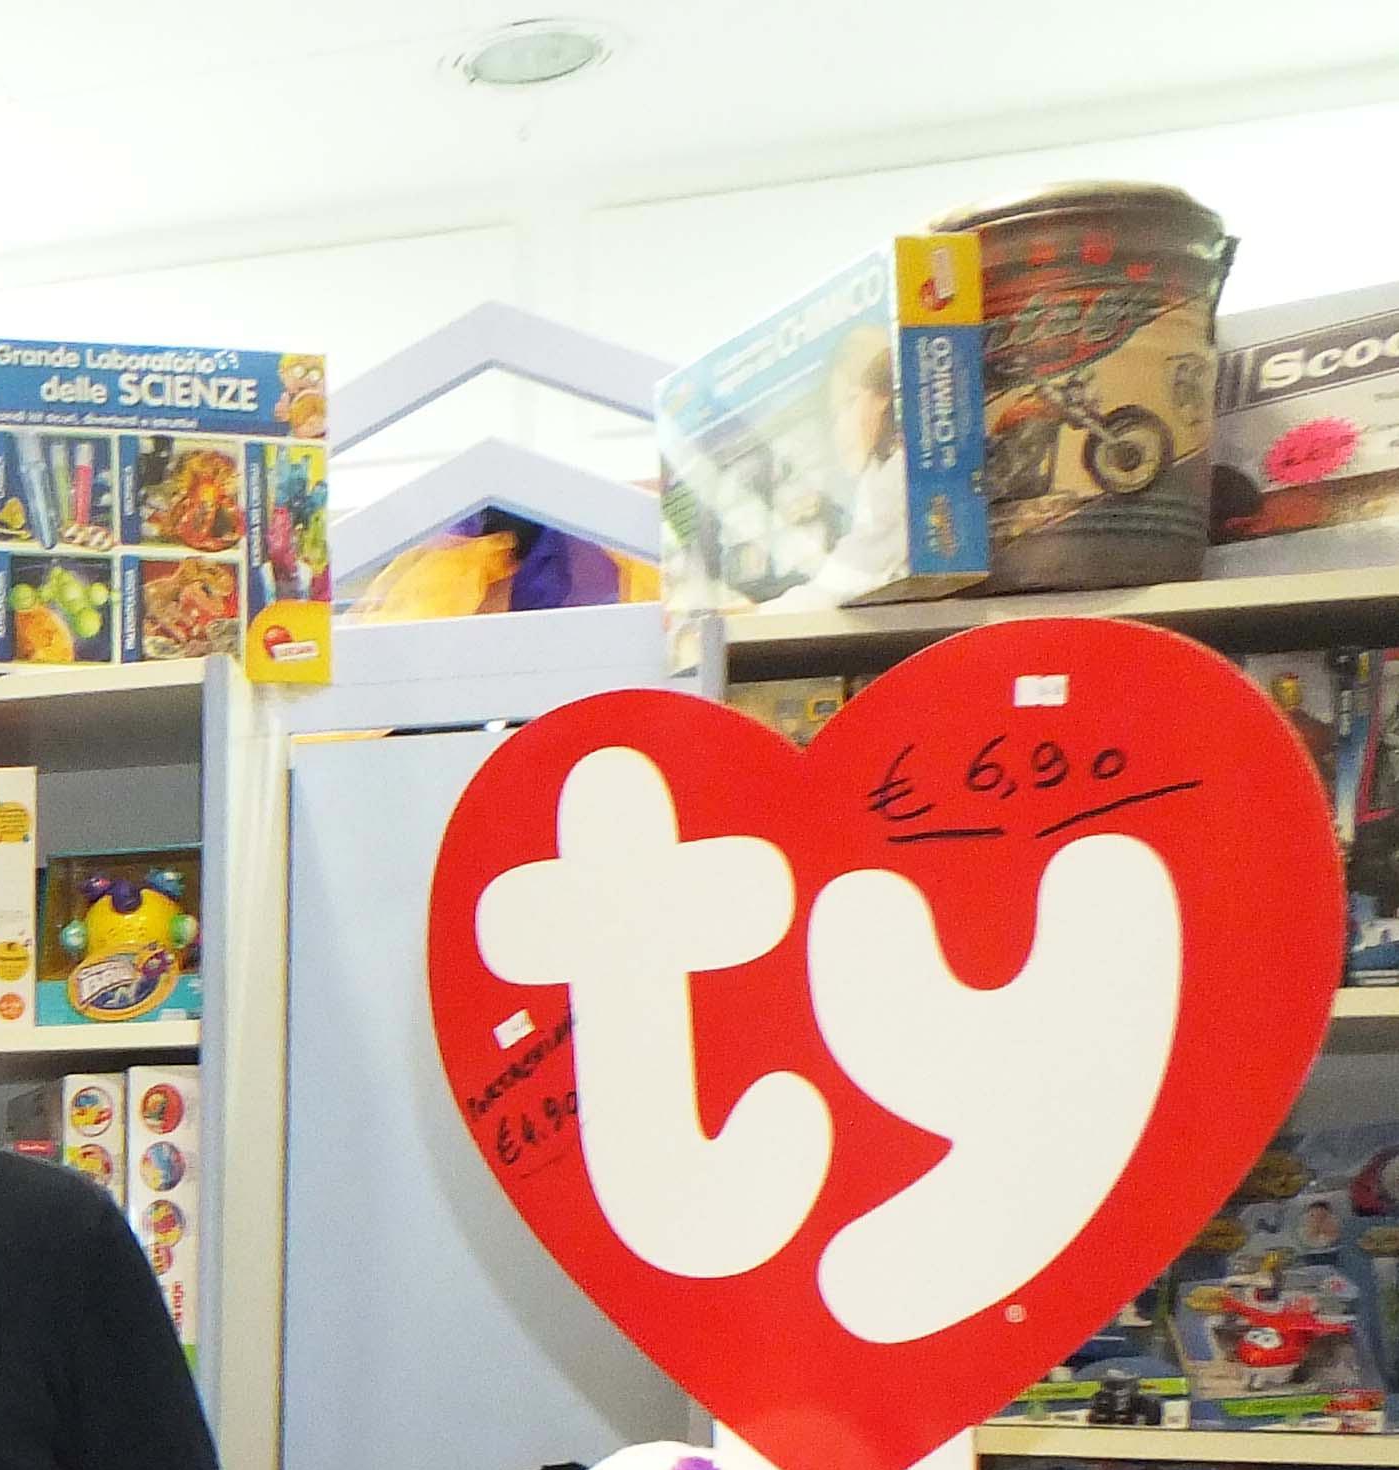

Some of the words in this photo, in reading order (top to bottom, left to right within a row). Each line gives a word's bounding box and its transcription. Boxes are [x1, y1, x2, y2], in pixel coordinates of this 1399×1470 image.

[85, 347, 216, 375] Laboratorio
[40, 376, 108, 405] delle
[118, 373, 259, 412] SCIENZE
[867, 742, 935, 820] €
[965, 734, 1129, 800] 6,90
[475, 746, 1183, 1344] ty
